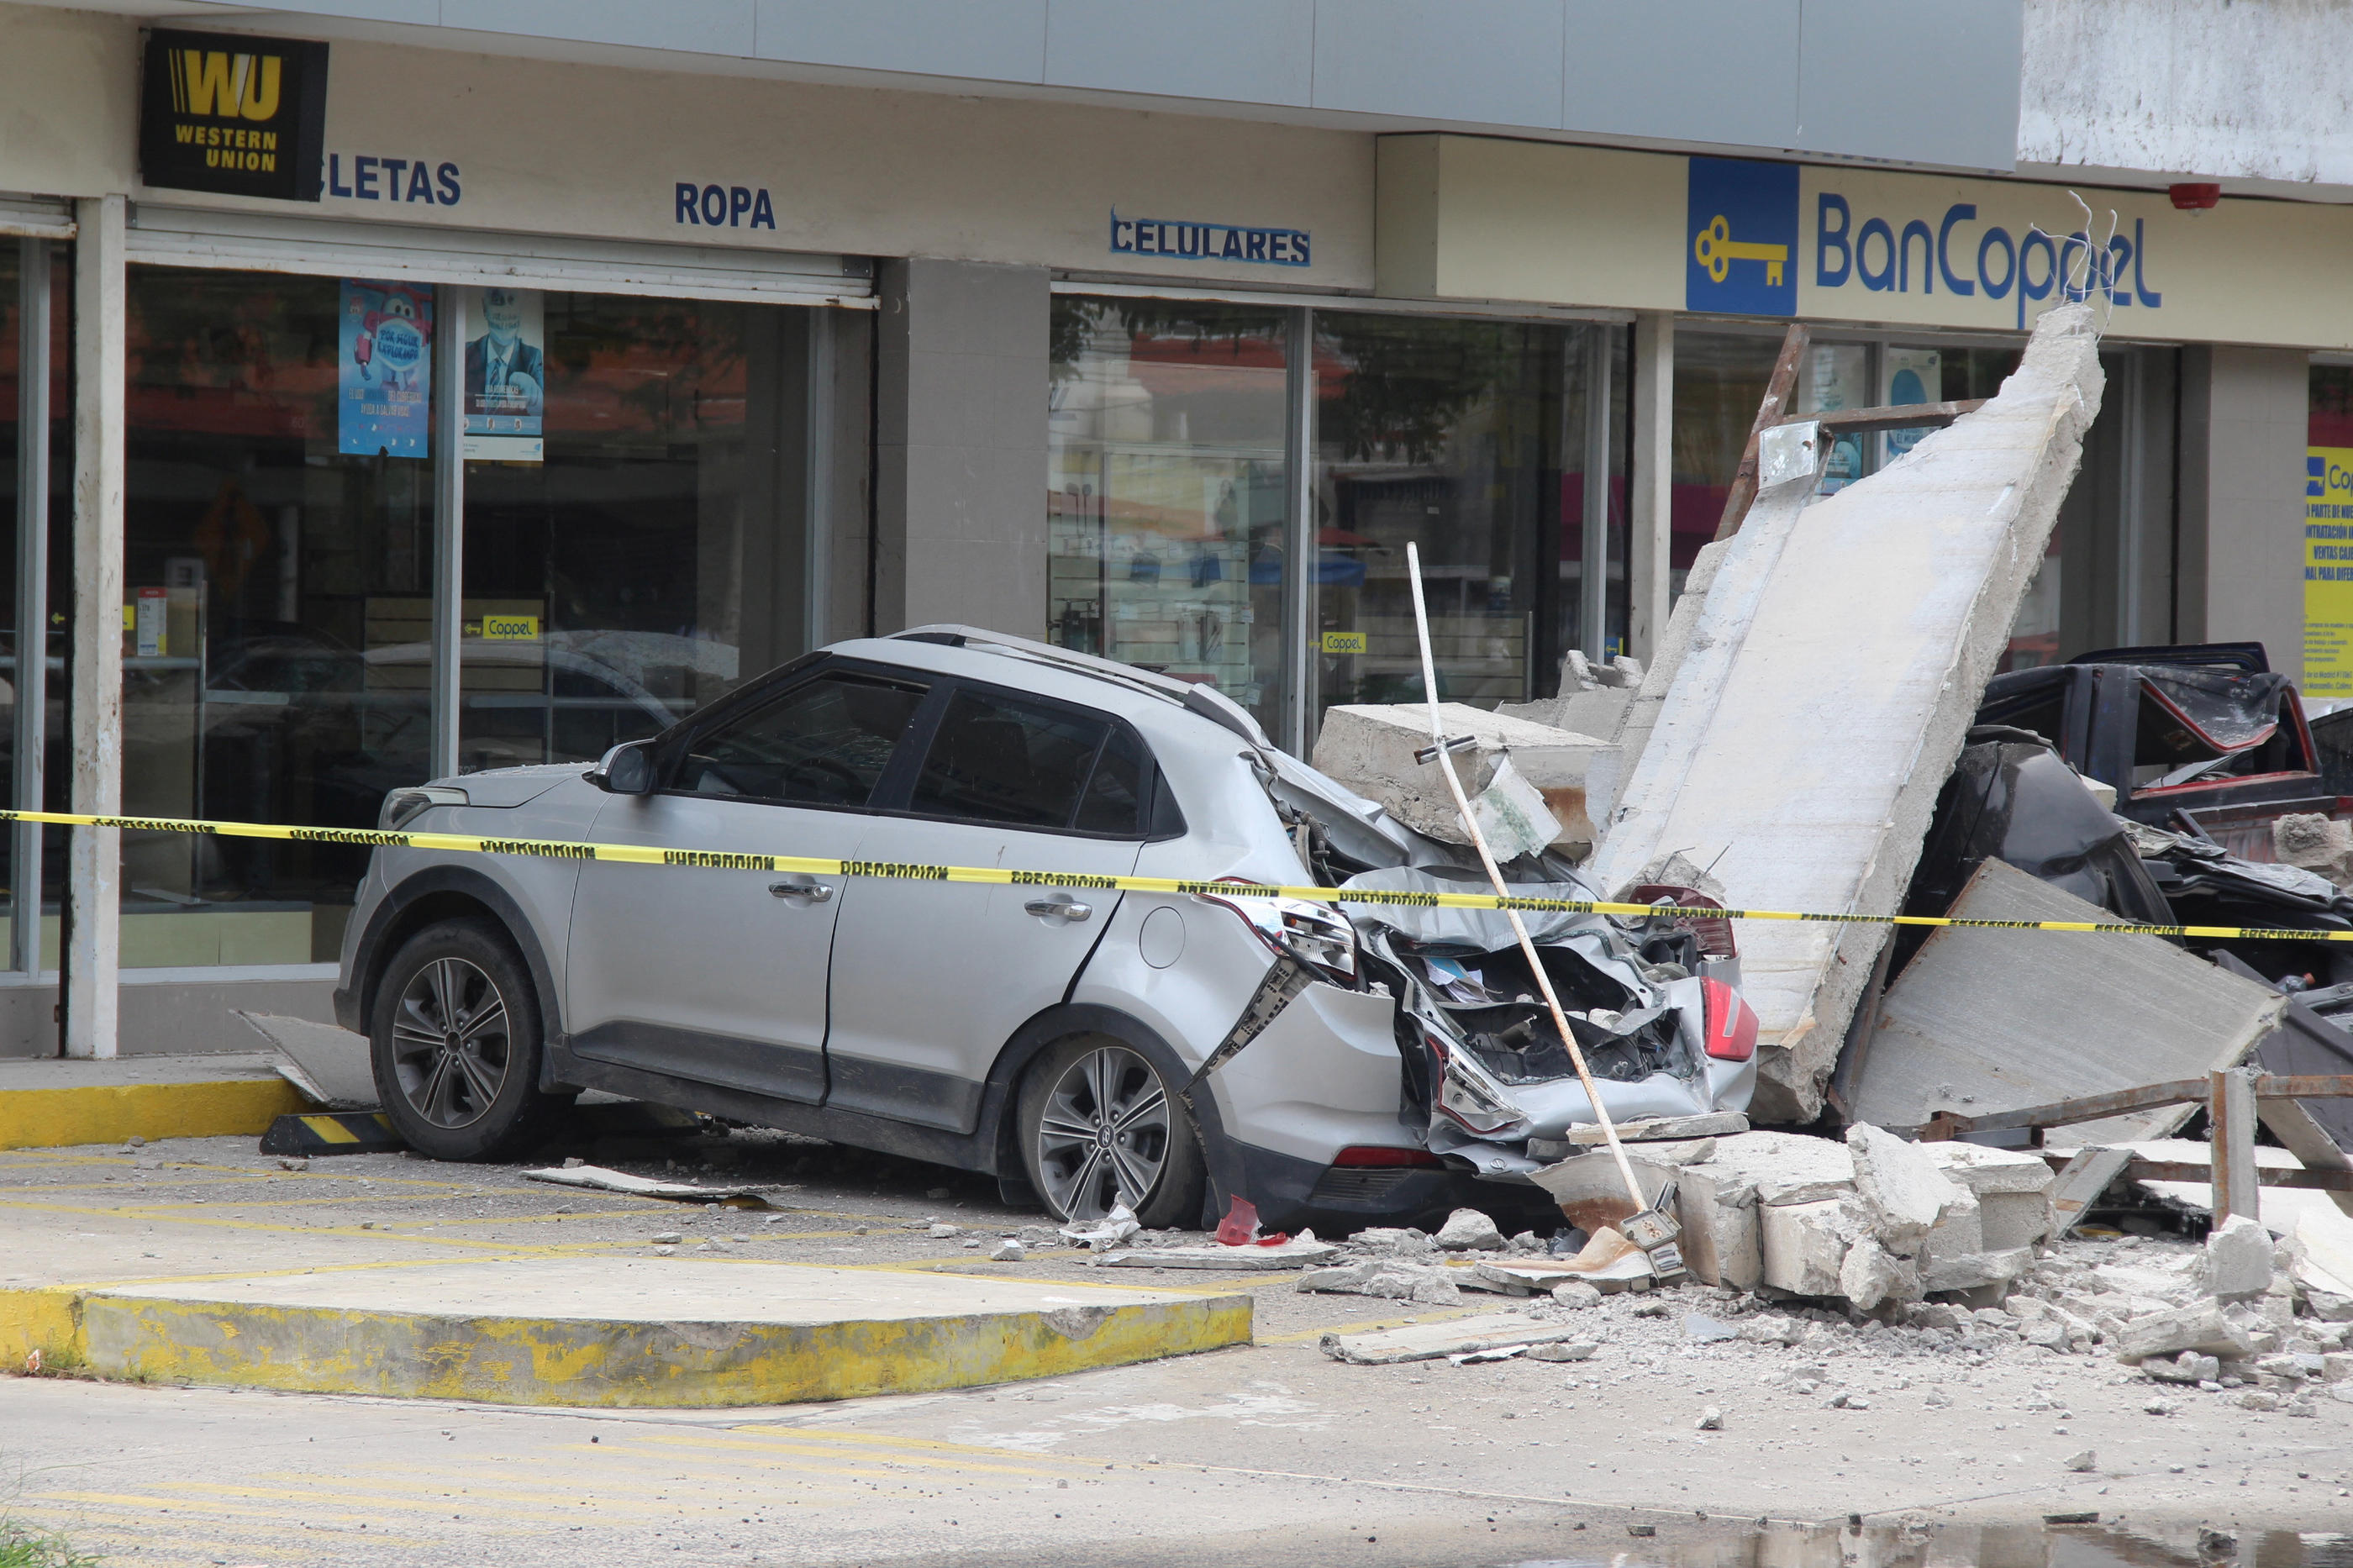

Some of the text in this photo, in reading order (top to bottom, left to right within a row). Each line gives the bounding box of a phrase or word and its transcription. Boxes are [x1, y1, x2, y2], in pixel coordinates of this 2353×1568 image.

[170, 48, 282, 121] WU
[176, 124, 277, 150] WESTERN
[206, 149, 276, 172] UNION
[320, 153, 461, 206] LETAS
[676, 182, 776, 229] ROPA
[1113, 220, 1309, 263] CELULARES
[2311, 504, 2331, 518] PARTE
[2332, 504, 2340, 518] DE
[2314, 545, 2338, 560] VENTAS
[2319, 566, 2335, 581] PARA
[489, 620, 532, 639] Coppel
[1327, 635, 1361, 652] Coppel
